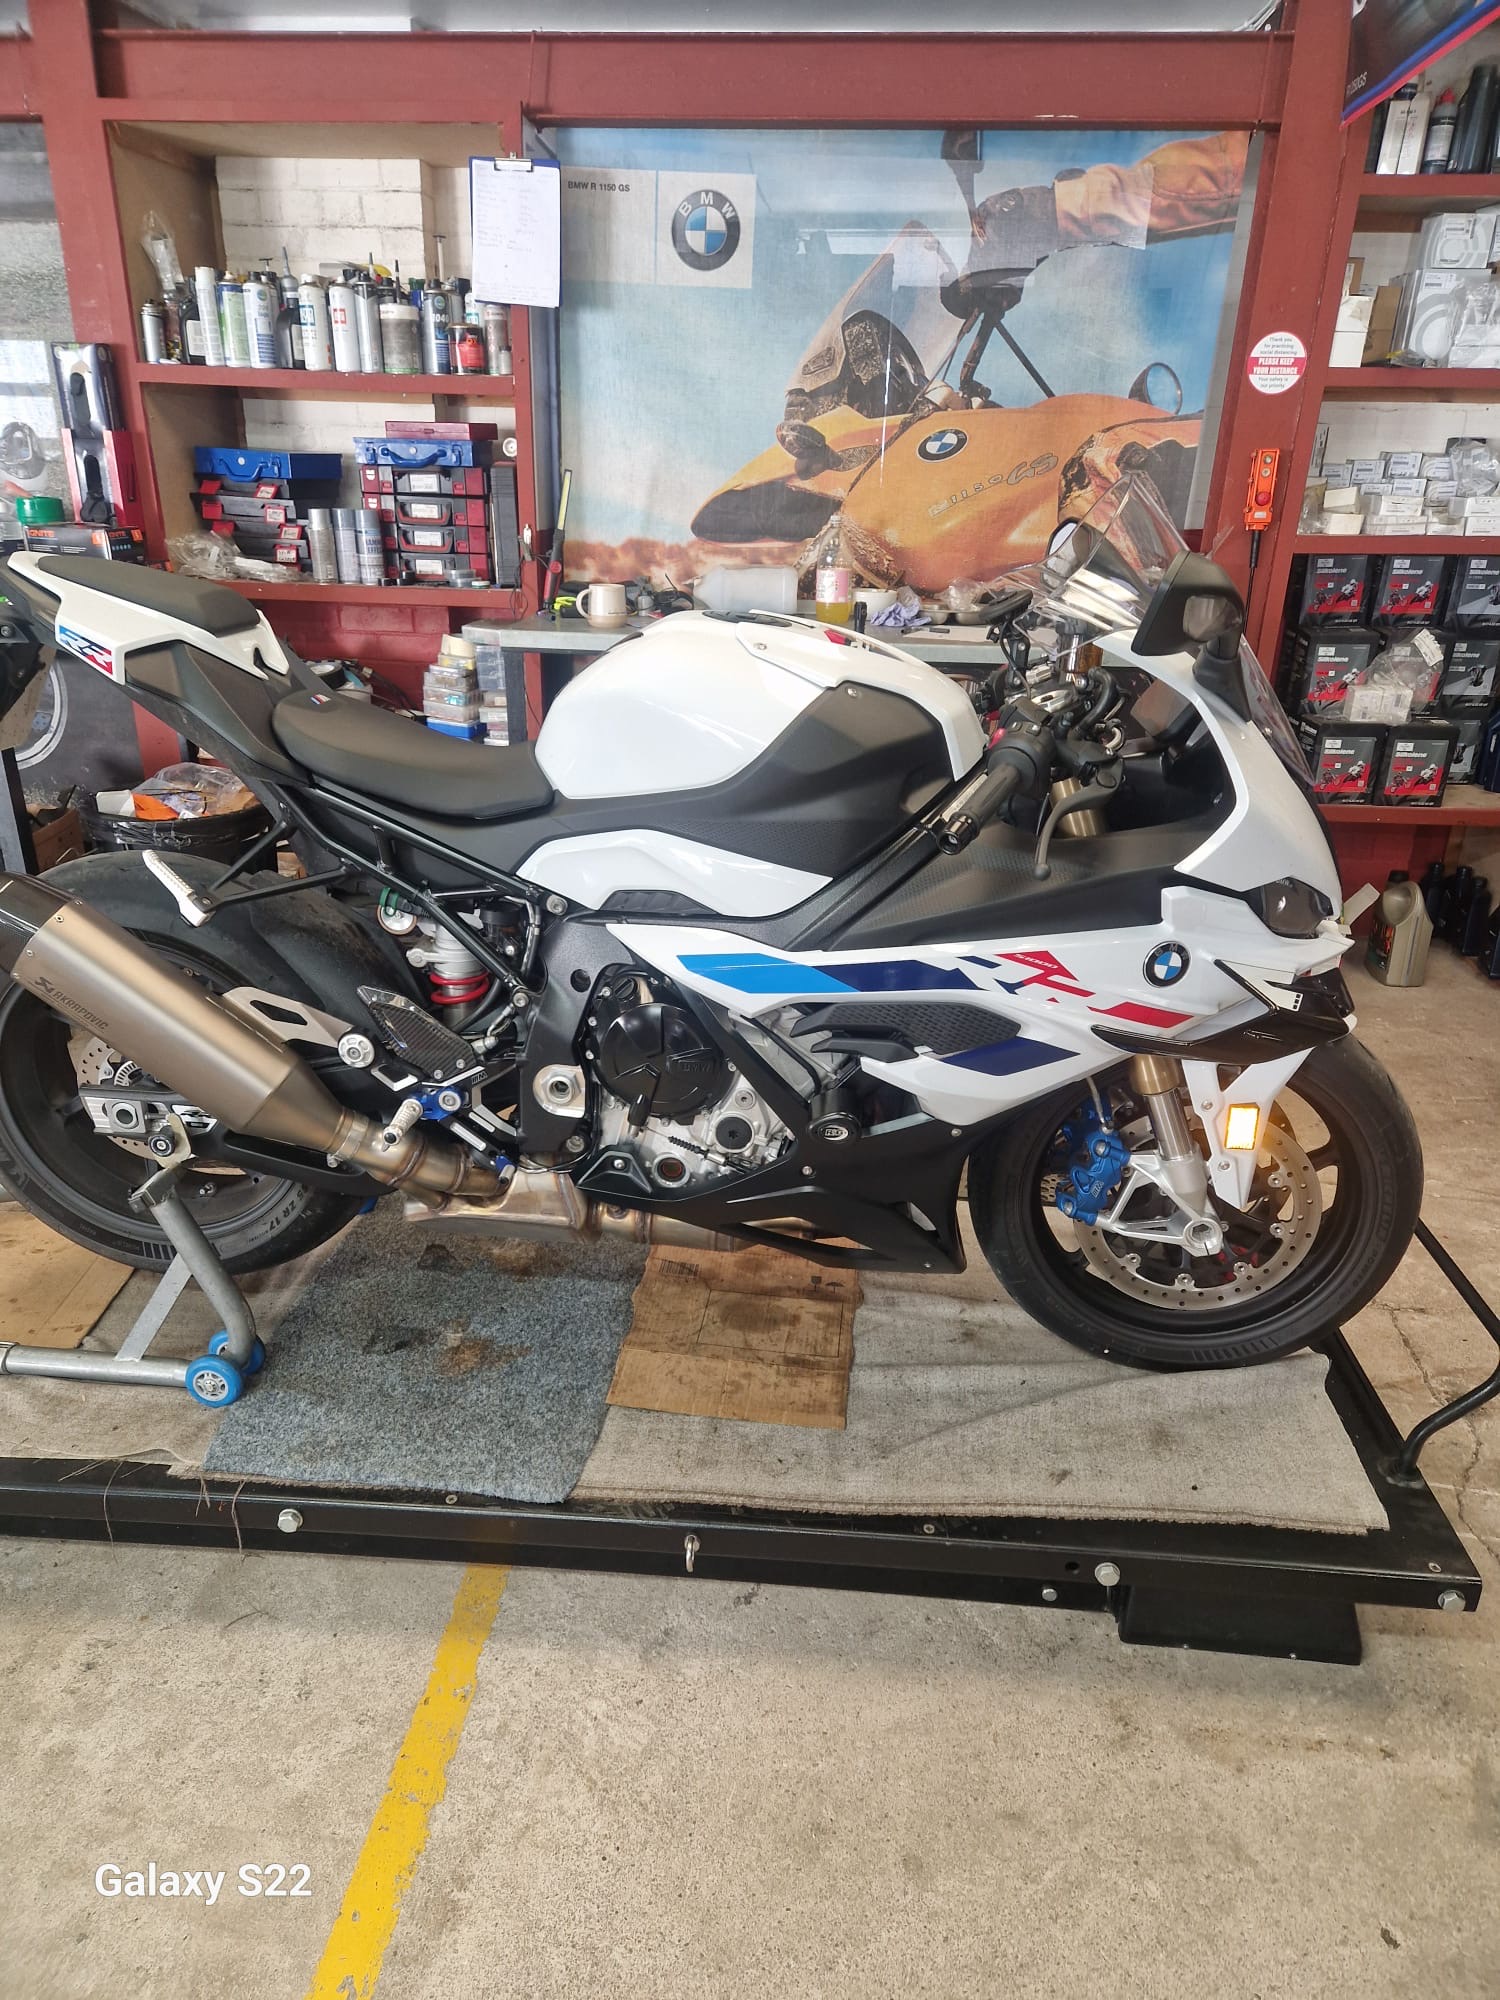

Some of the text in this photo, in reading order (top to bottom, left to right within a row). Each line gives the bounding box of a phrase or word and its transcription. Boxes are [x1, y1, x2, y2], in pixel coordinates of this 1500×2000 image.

[567, 181, 631, 192] BMW R 1150 GS
[678, 191, 736, 219] BMW
[1258, 357, 1295, 366] PLEASE KEEP
[1269, 367, 1298, 375] DISTANCE
[1013, 953, 1059, 969] S1000
[268, 1200, 297, 1232] ZR 17
